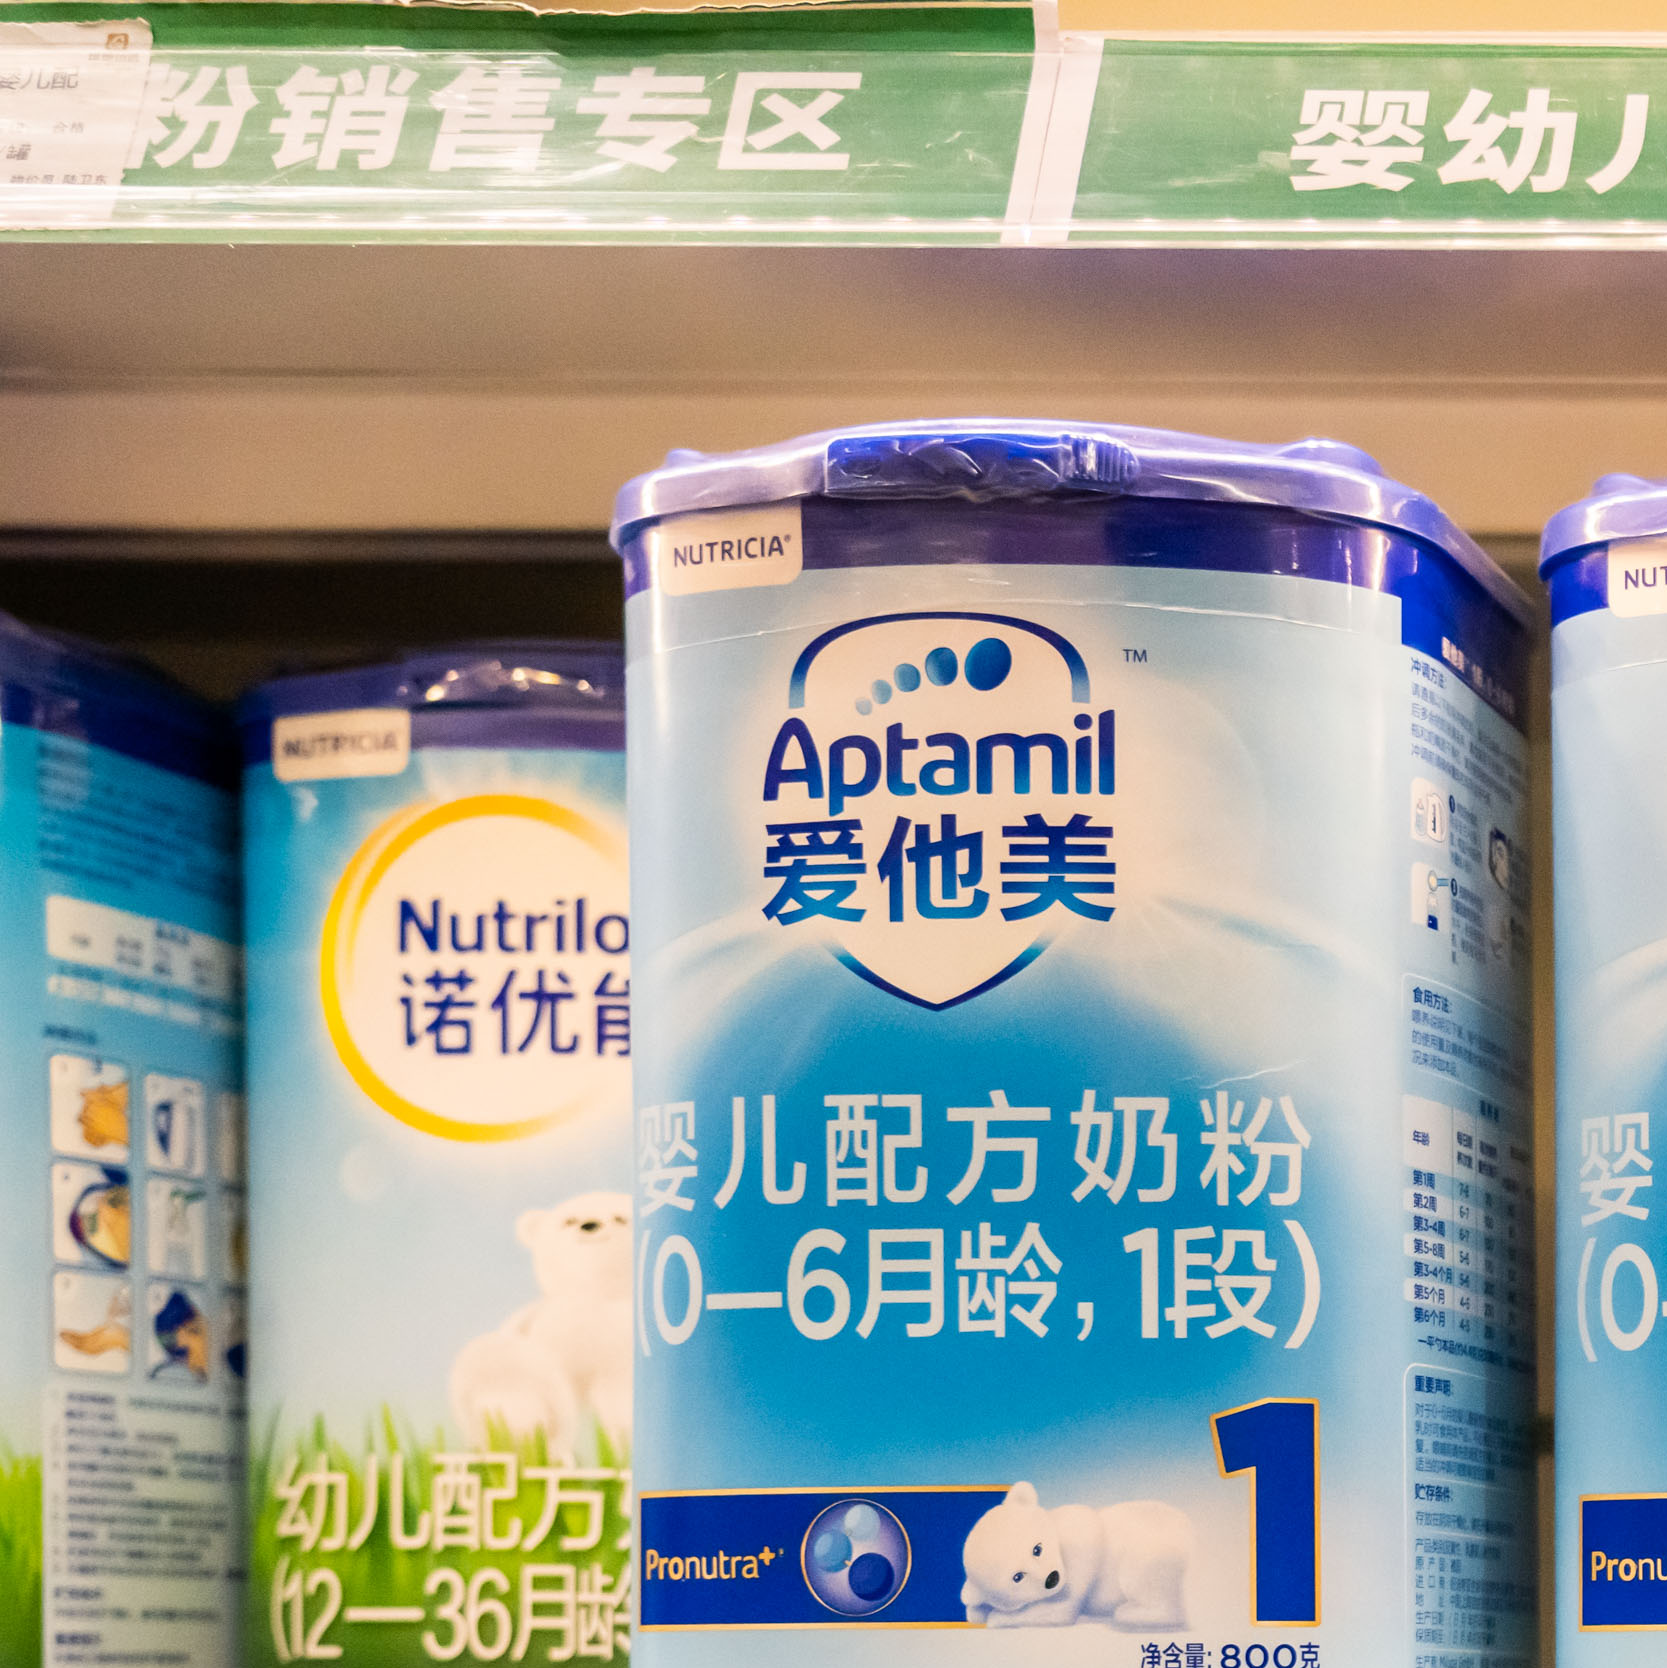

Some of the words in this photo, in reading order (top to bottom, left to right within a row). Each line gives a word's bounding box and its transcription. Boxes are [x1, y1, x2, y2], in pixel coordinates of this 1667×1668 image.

[762, 708, 1117, 818] Aptamil
[761, 812, 1117, 927] 爱他美
[637, 1089, 1312, 1214] 婴儿配方奶粉
[274, 1452, 632, 1554] 幼儿配方
[1209, 1396, 1322, 1629] 1
